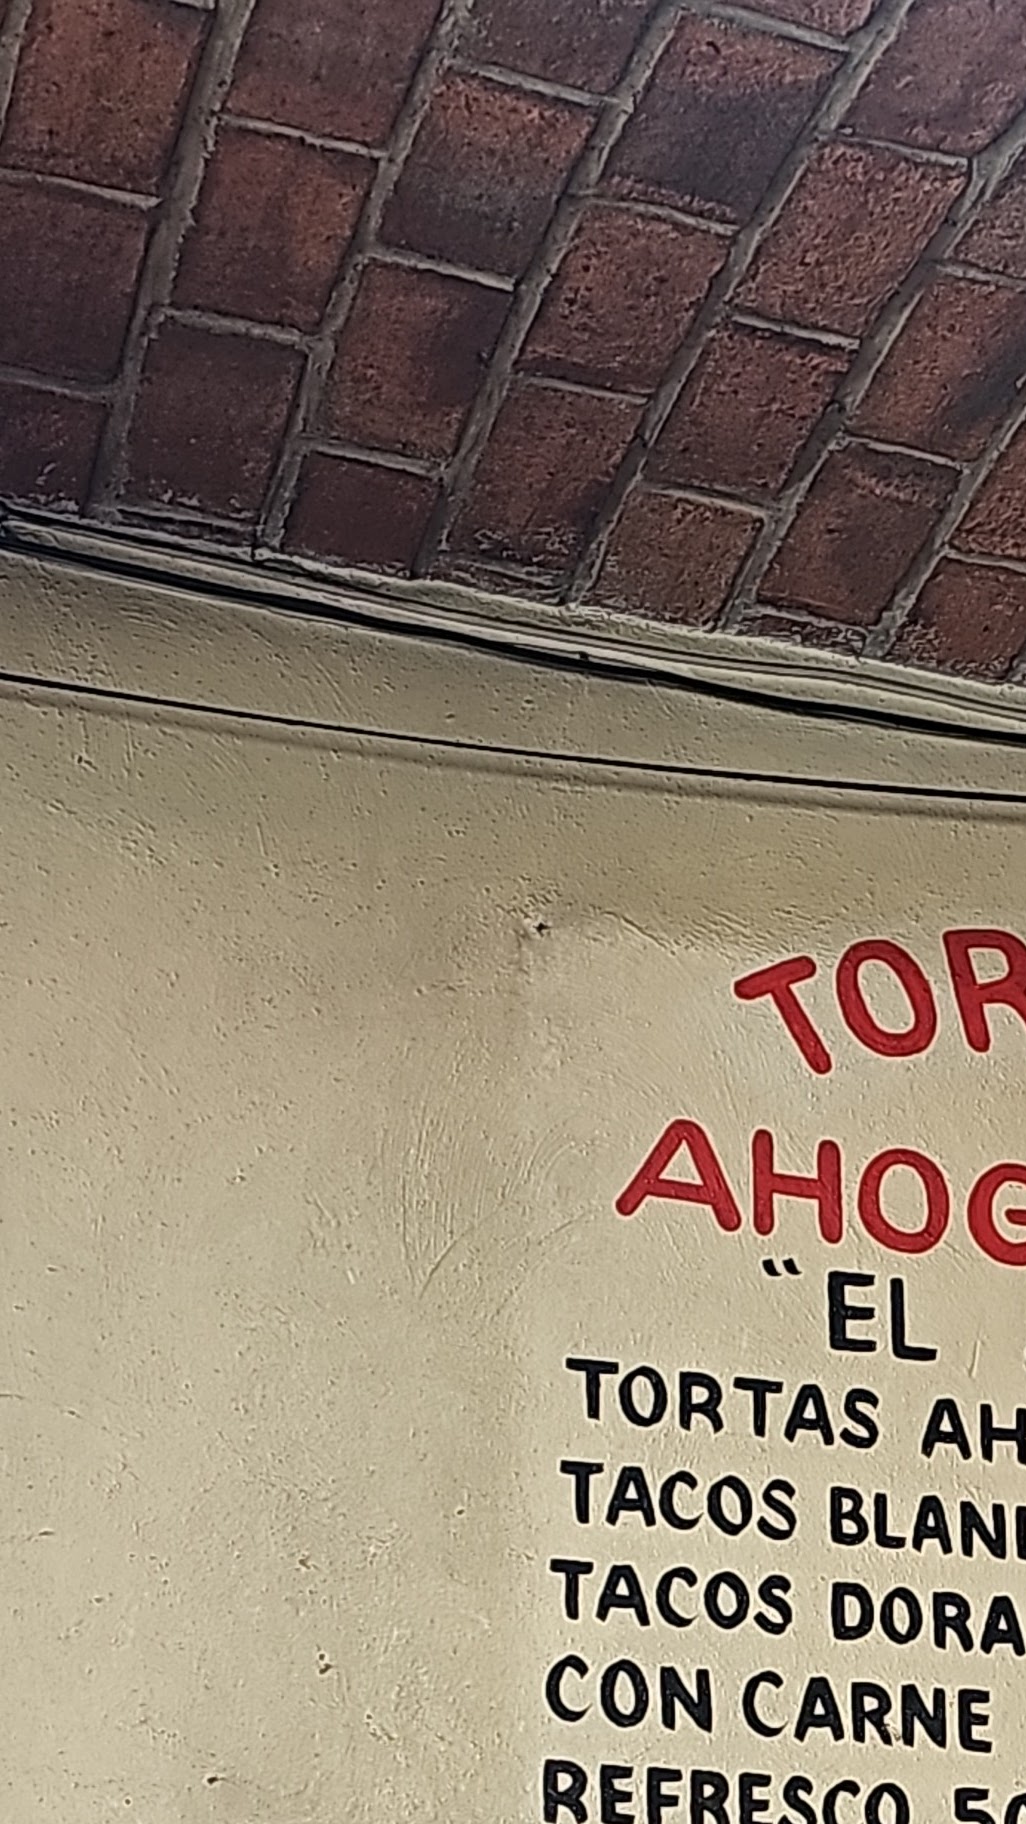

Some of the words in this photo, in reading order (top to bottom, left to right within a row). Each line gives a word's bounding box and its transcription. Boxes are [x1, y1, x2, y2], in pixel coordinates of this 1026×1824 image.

[564, 1356, 880, 1450] TORTAS
[559, 1459, 798, 1542] TACOS
[549, 1557, 794, 1636] TACOS
[544, 1653, 714, 1734] CON
[741, 1669, 993, 1755] CARNE
